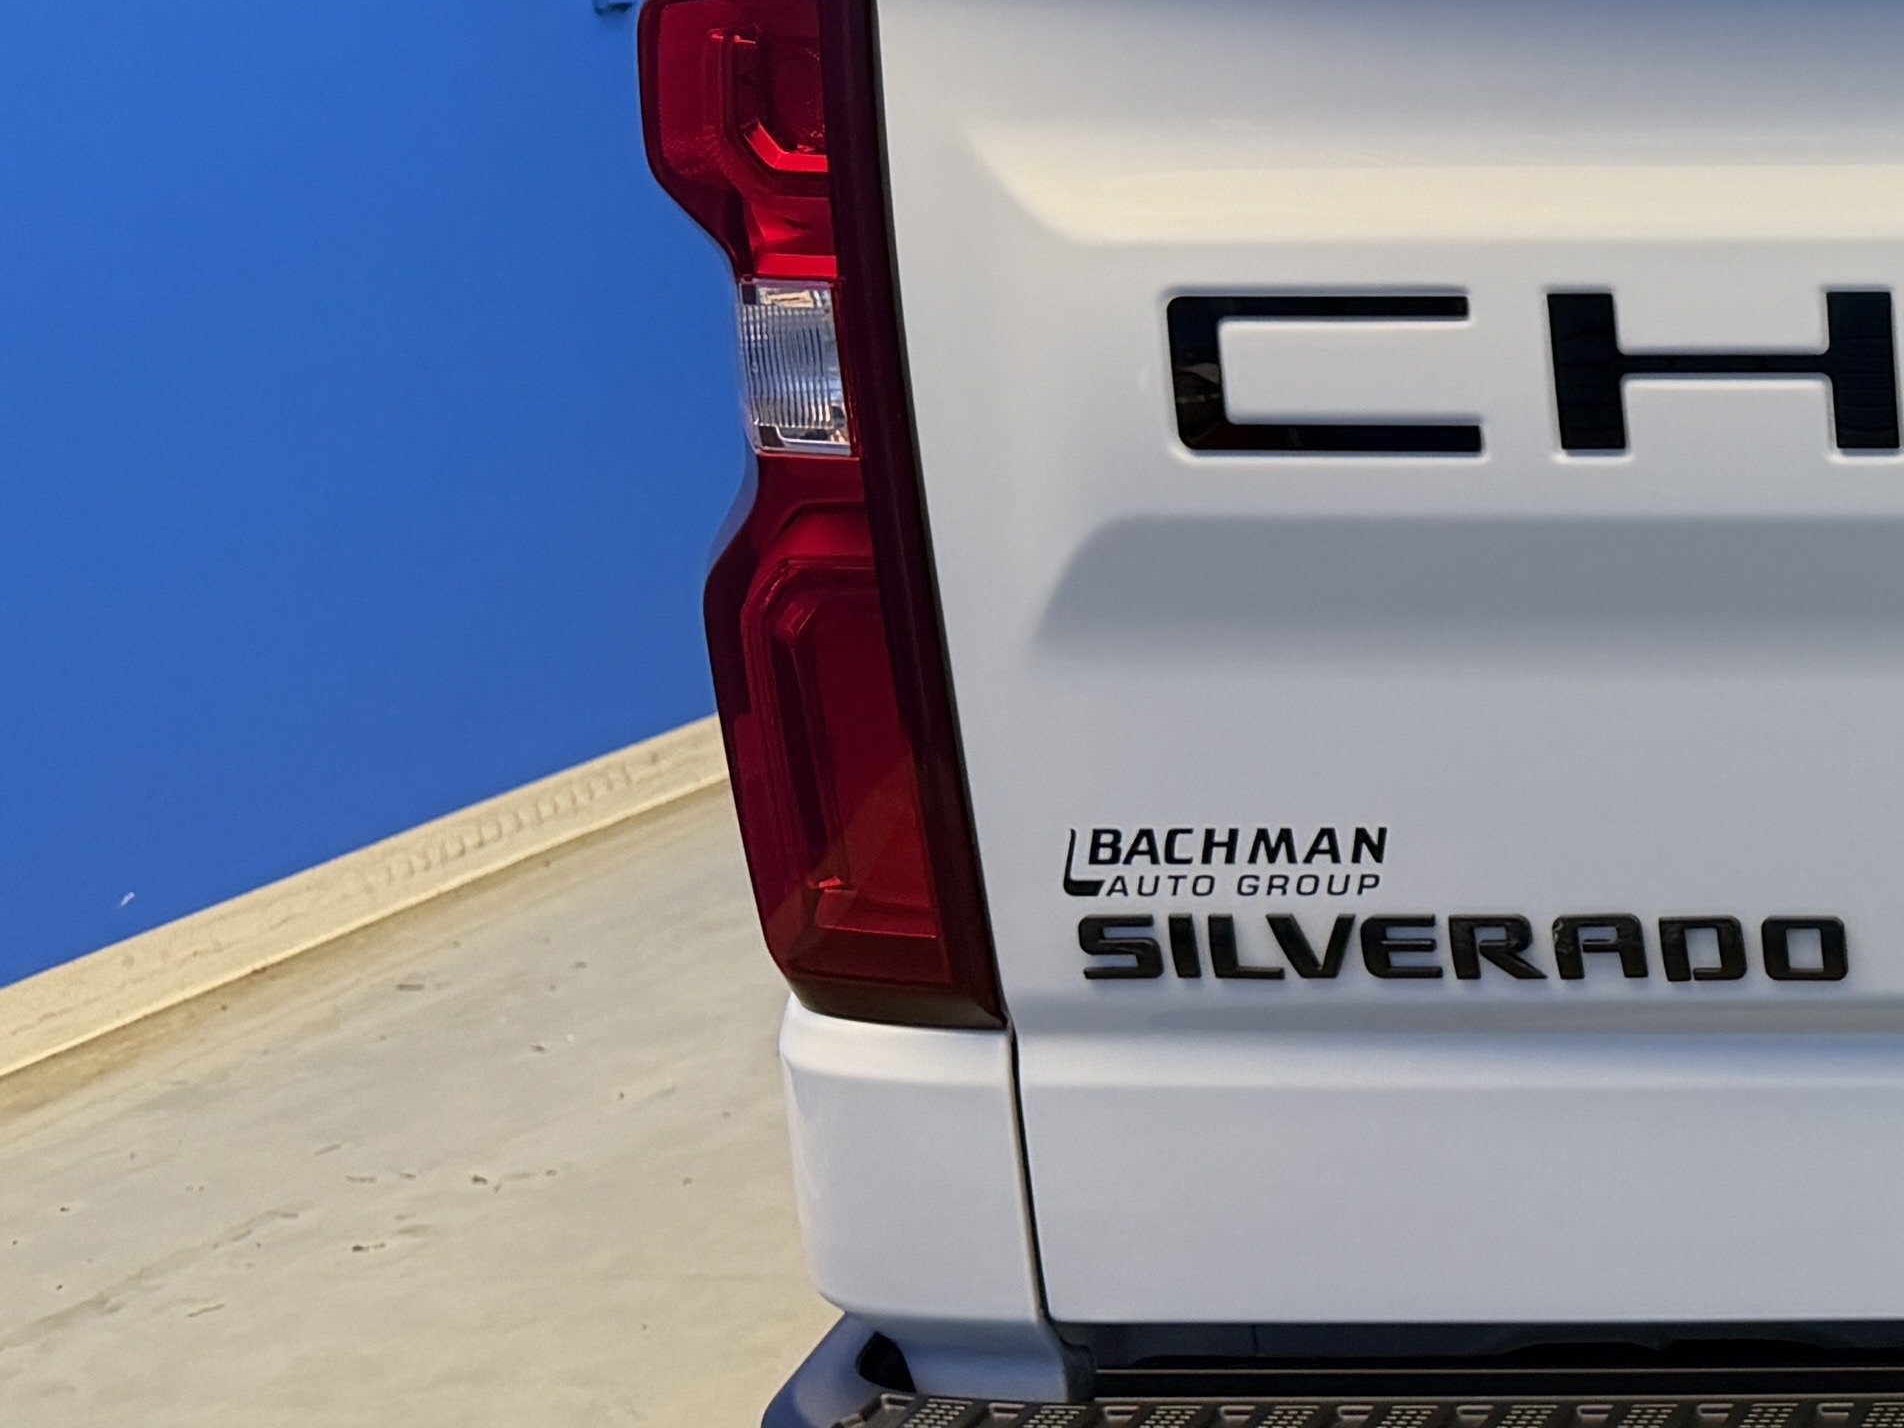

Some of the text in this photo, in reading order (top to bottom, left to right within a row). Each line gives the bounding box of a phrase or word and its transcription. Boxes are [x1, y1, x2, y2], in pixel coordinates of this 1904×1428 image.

[1087, 827, 1387, 865] BACHMAN
[1105, 874, 1381, 897] AUTO GROUP
[1077, 913, 1849, 982] SILVERADO
